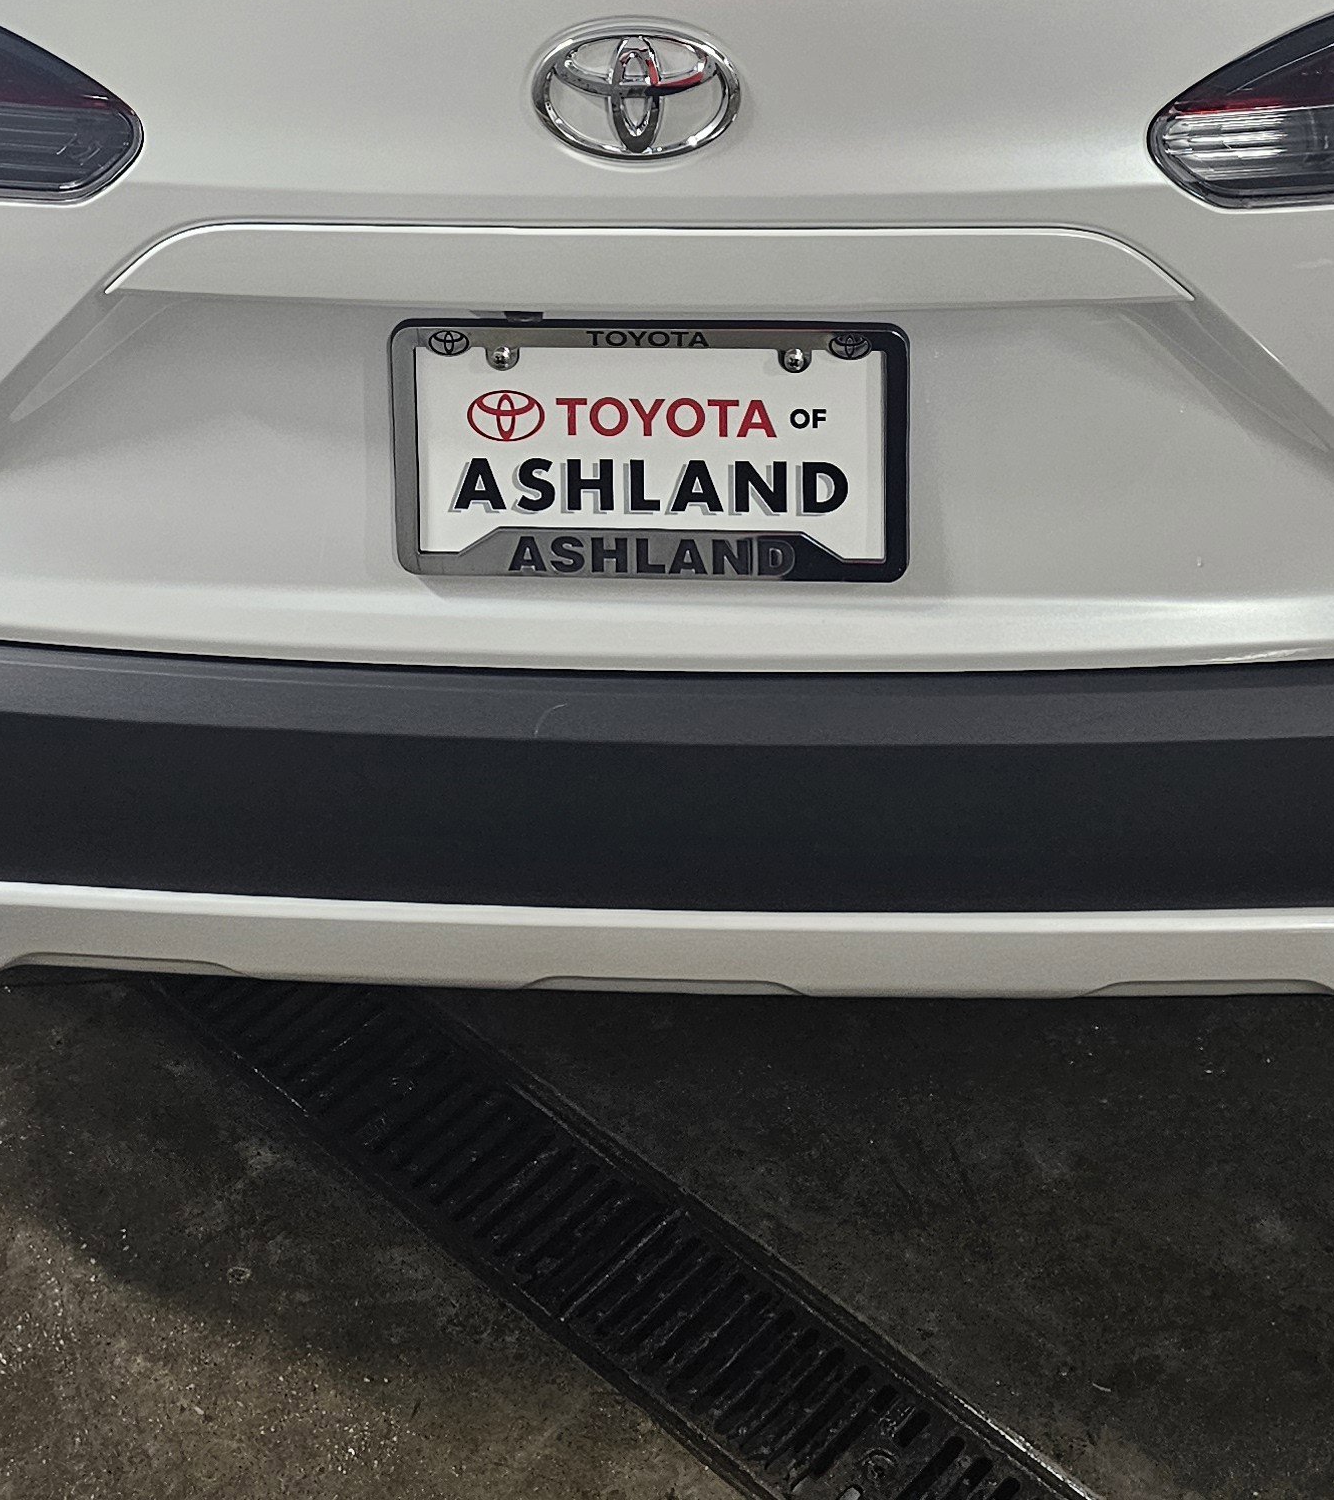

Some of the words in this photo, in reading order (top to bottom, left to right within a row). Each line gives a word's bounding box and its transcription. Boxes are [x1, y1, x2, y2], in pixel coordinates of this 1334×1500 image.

[585, 329, 710, 348] TOYOTA
[555, 397, 777, 439] TOYOTA
[789, 408, 827, 430] OF
[448, 457, 849, 516] ASHLAND
[508, 535, 797, 577] ASHLAND
